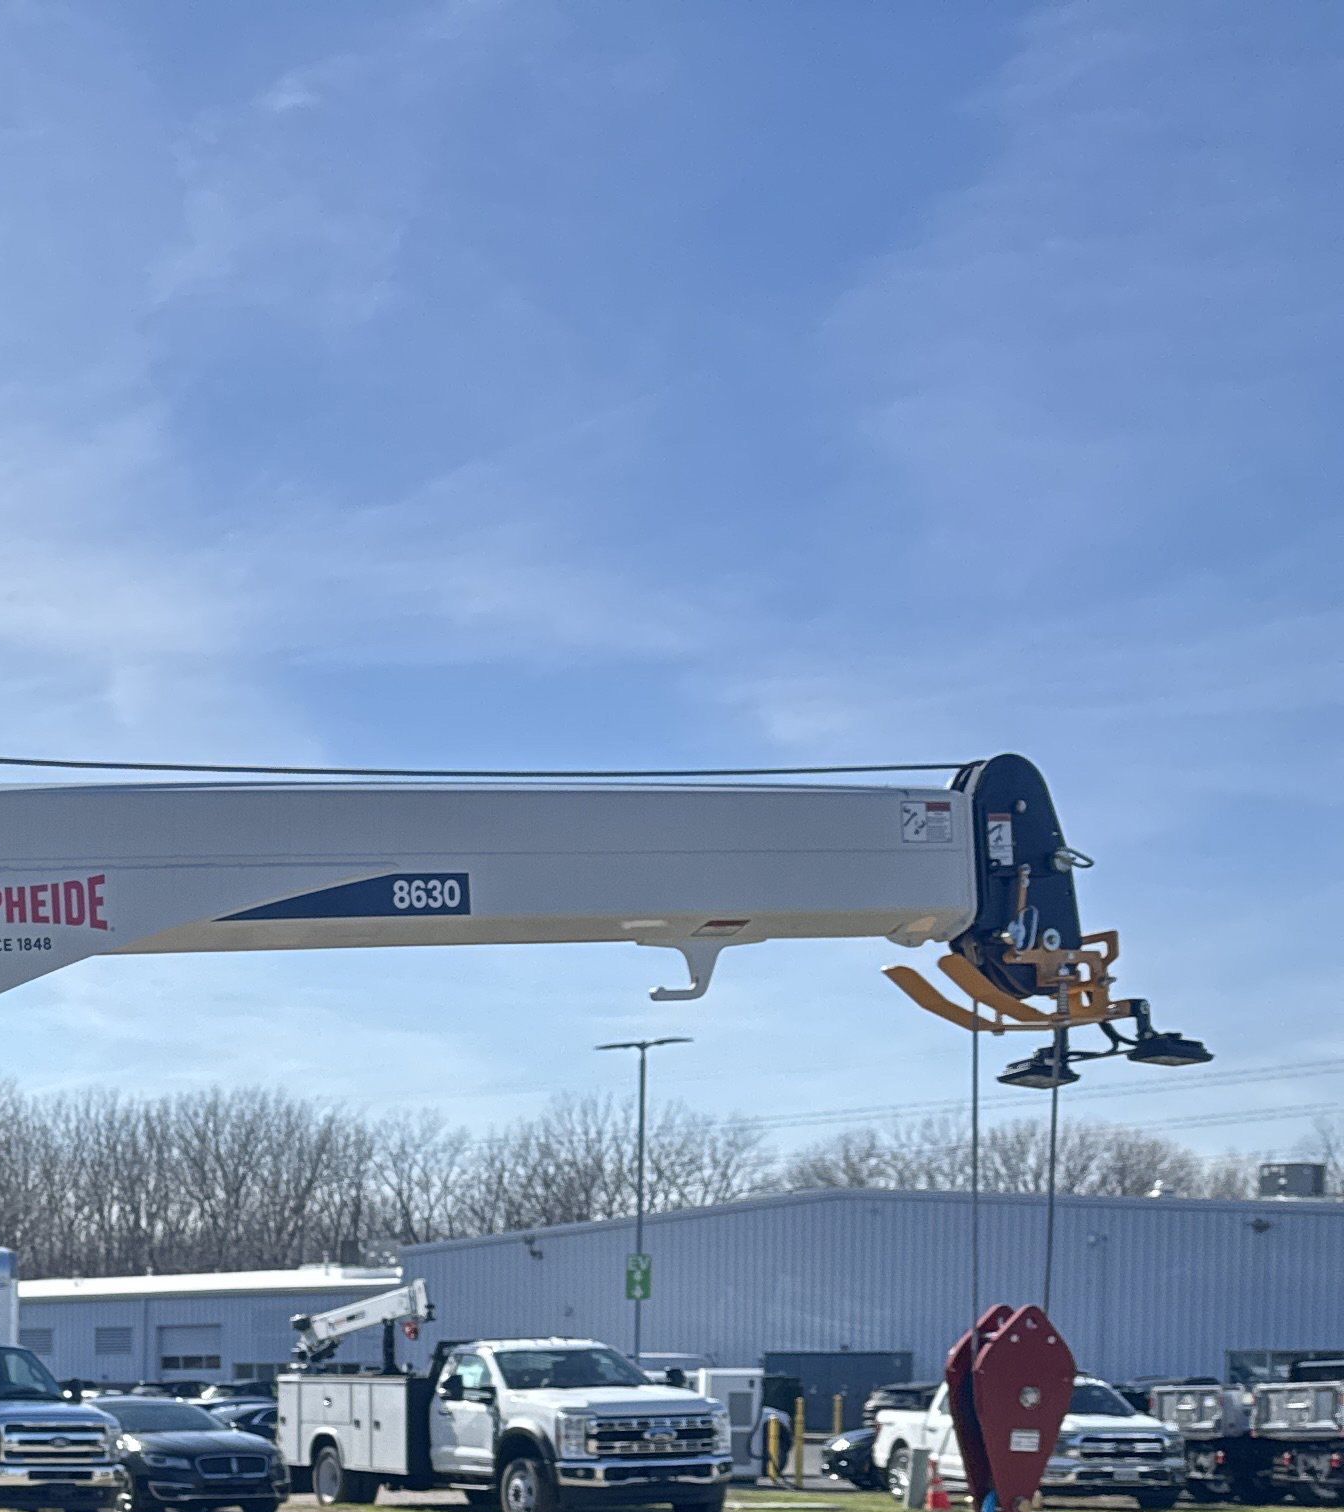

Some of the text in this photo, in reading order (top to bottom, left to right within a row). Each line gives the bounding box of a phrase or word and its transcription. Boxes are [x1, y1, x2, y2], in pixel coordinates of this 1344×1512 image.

[393, 879, 461, 909] 8630
[17, 937, 52, 951] 1848
[628, 1256, 650, 1271] EV
